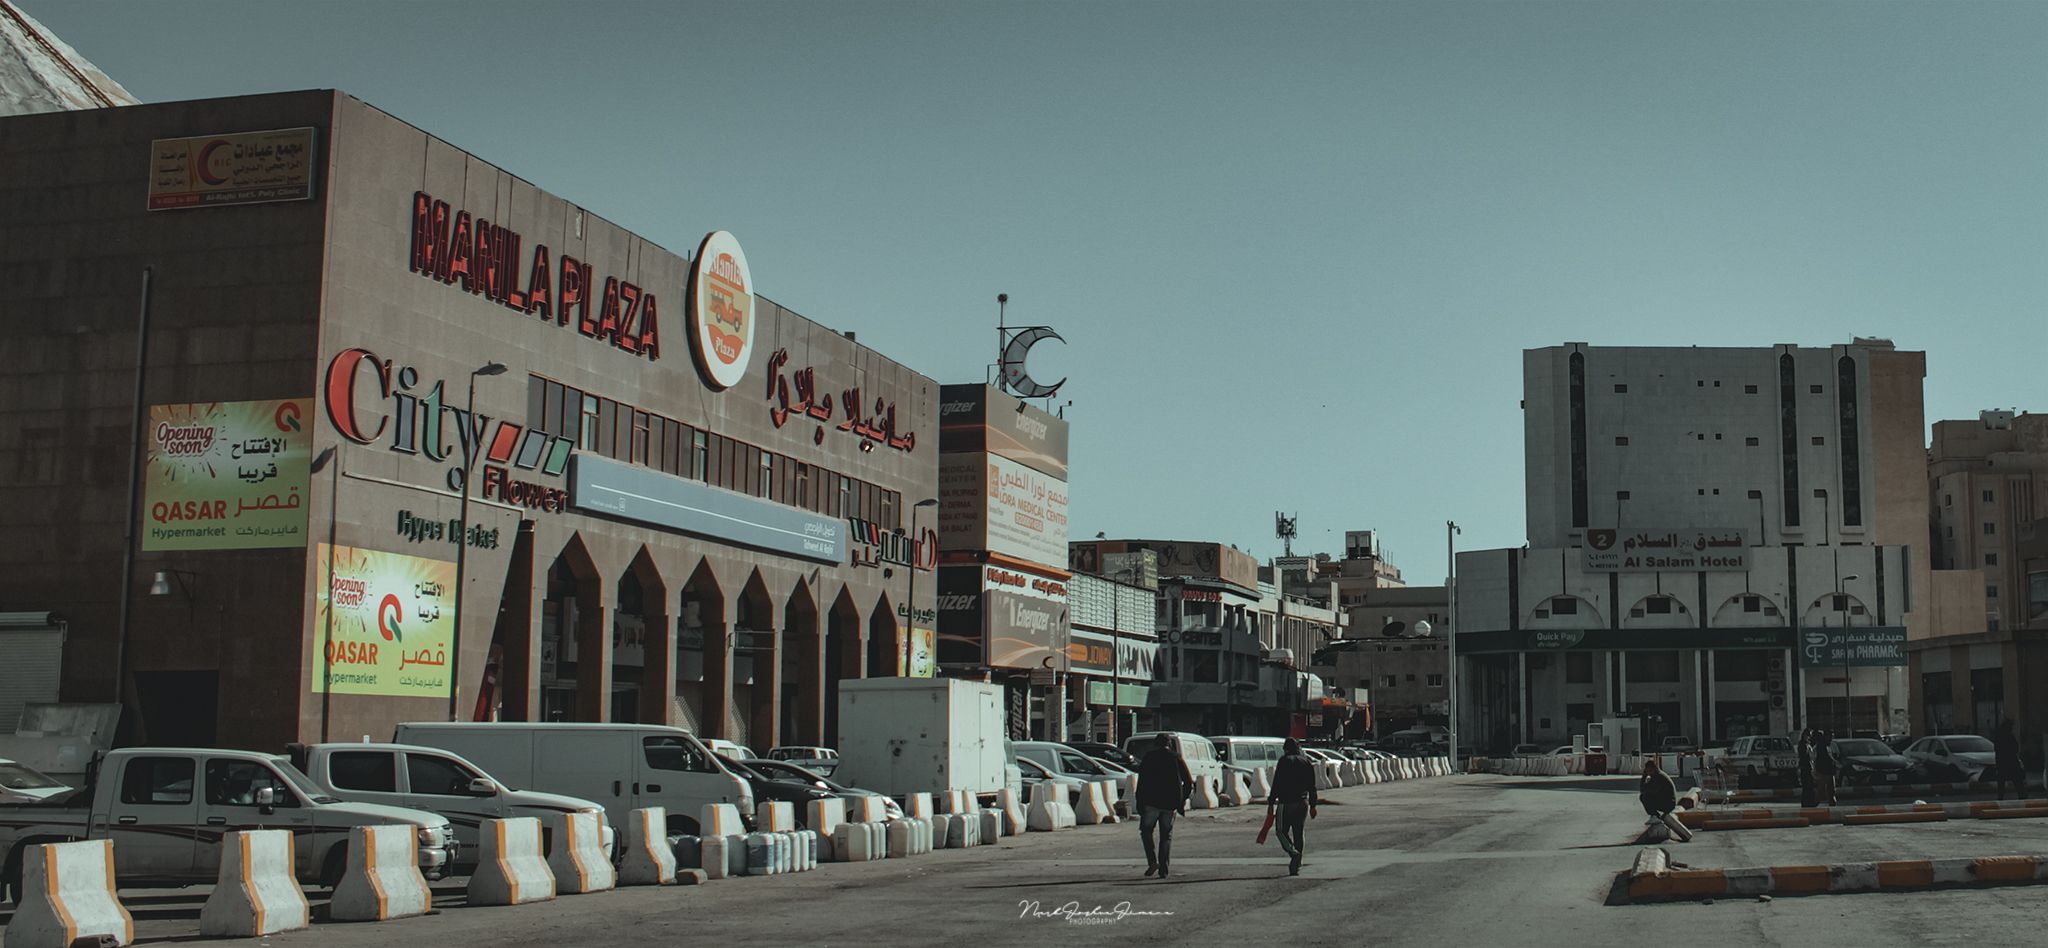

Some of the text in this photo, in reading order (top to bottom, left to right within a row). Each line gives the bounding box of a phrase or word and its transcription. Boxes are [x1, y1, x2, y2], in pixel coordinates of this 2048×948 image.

[410, 190, 660, 361] MANILA PLAZA
[715, 336, 736, 359] Plaza
[324, 347, 495, 490] City
[157, 422, 214, 449] Opening
[168, 440, 202, 455] soon
[238, 462, 278, 484] قريبا
[234, 486, 300, 517] قصر
[483, 464, 568, 514] Flower
[151, 499, 227, 524] QASAR
[1000, 491, 1016, 509] LORA
[1017, 498, 1045, 519] MEDICAL
[1046, 509, 1067, 526] CENTER
[152, 526, 226, 540] Hypermarket
[397, 509, 447, 543] Hyper
[1597, 534, 1607, 547] 2
[1623, 533, 1678, 554] السلام
[1693, 533, 1742, 551] فندق
[1624, 556, 1639, 568] Al
[1646, 556, 1695, 568] Salam
[1700, 556, 1742, 568] Hotel
[330, 569, 365, 601] Opening
[336, 591, 359, 606] soon
[1016, 602, 1050, 635] Energizer
[1537, 632, 1576, 642] Quick Pay
[1868, 632, 1904, 643] صيدلية
[324, 639, 378, 666] QASAR
[398, 642, 445, 671] قصر
